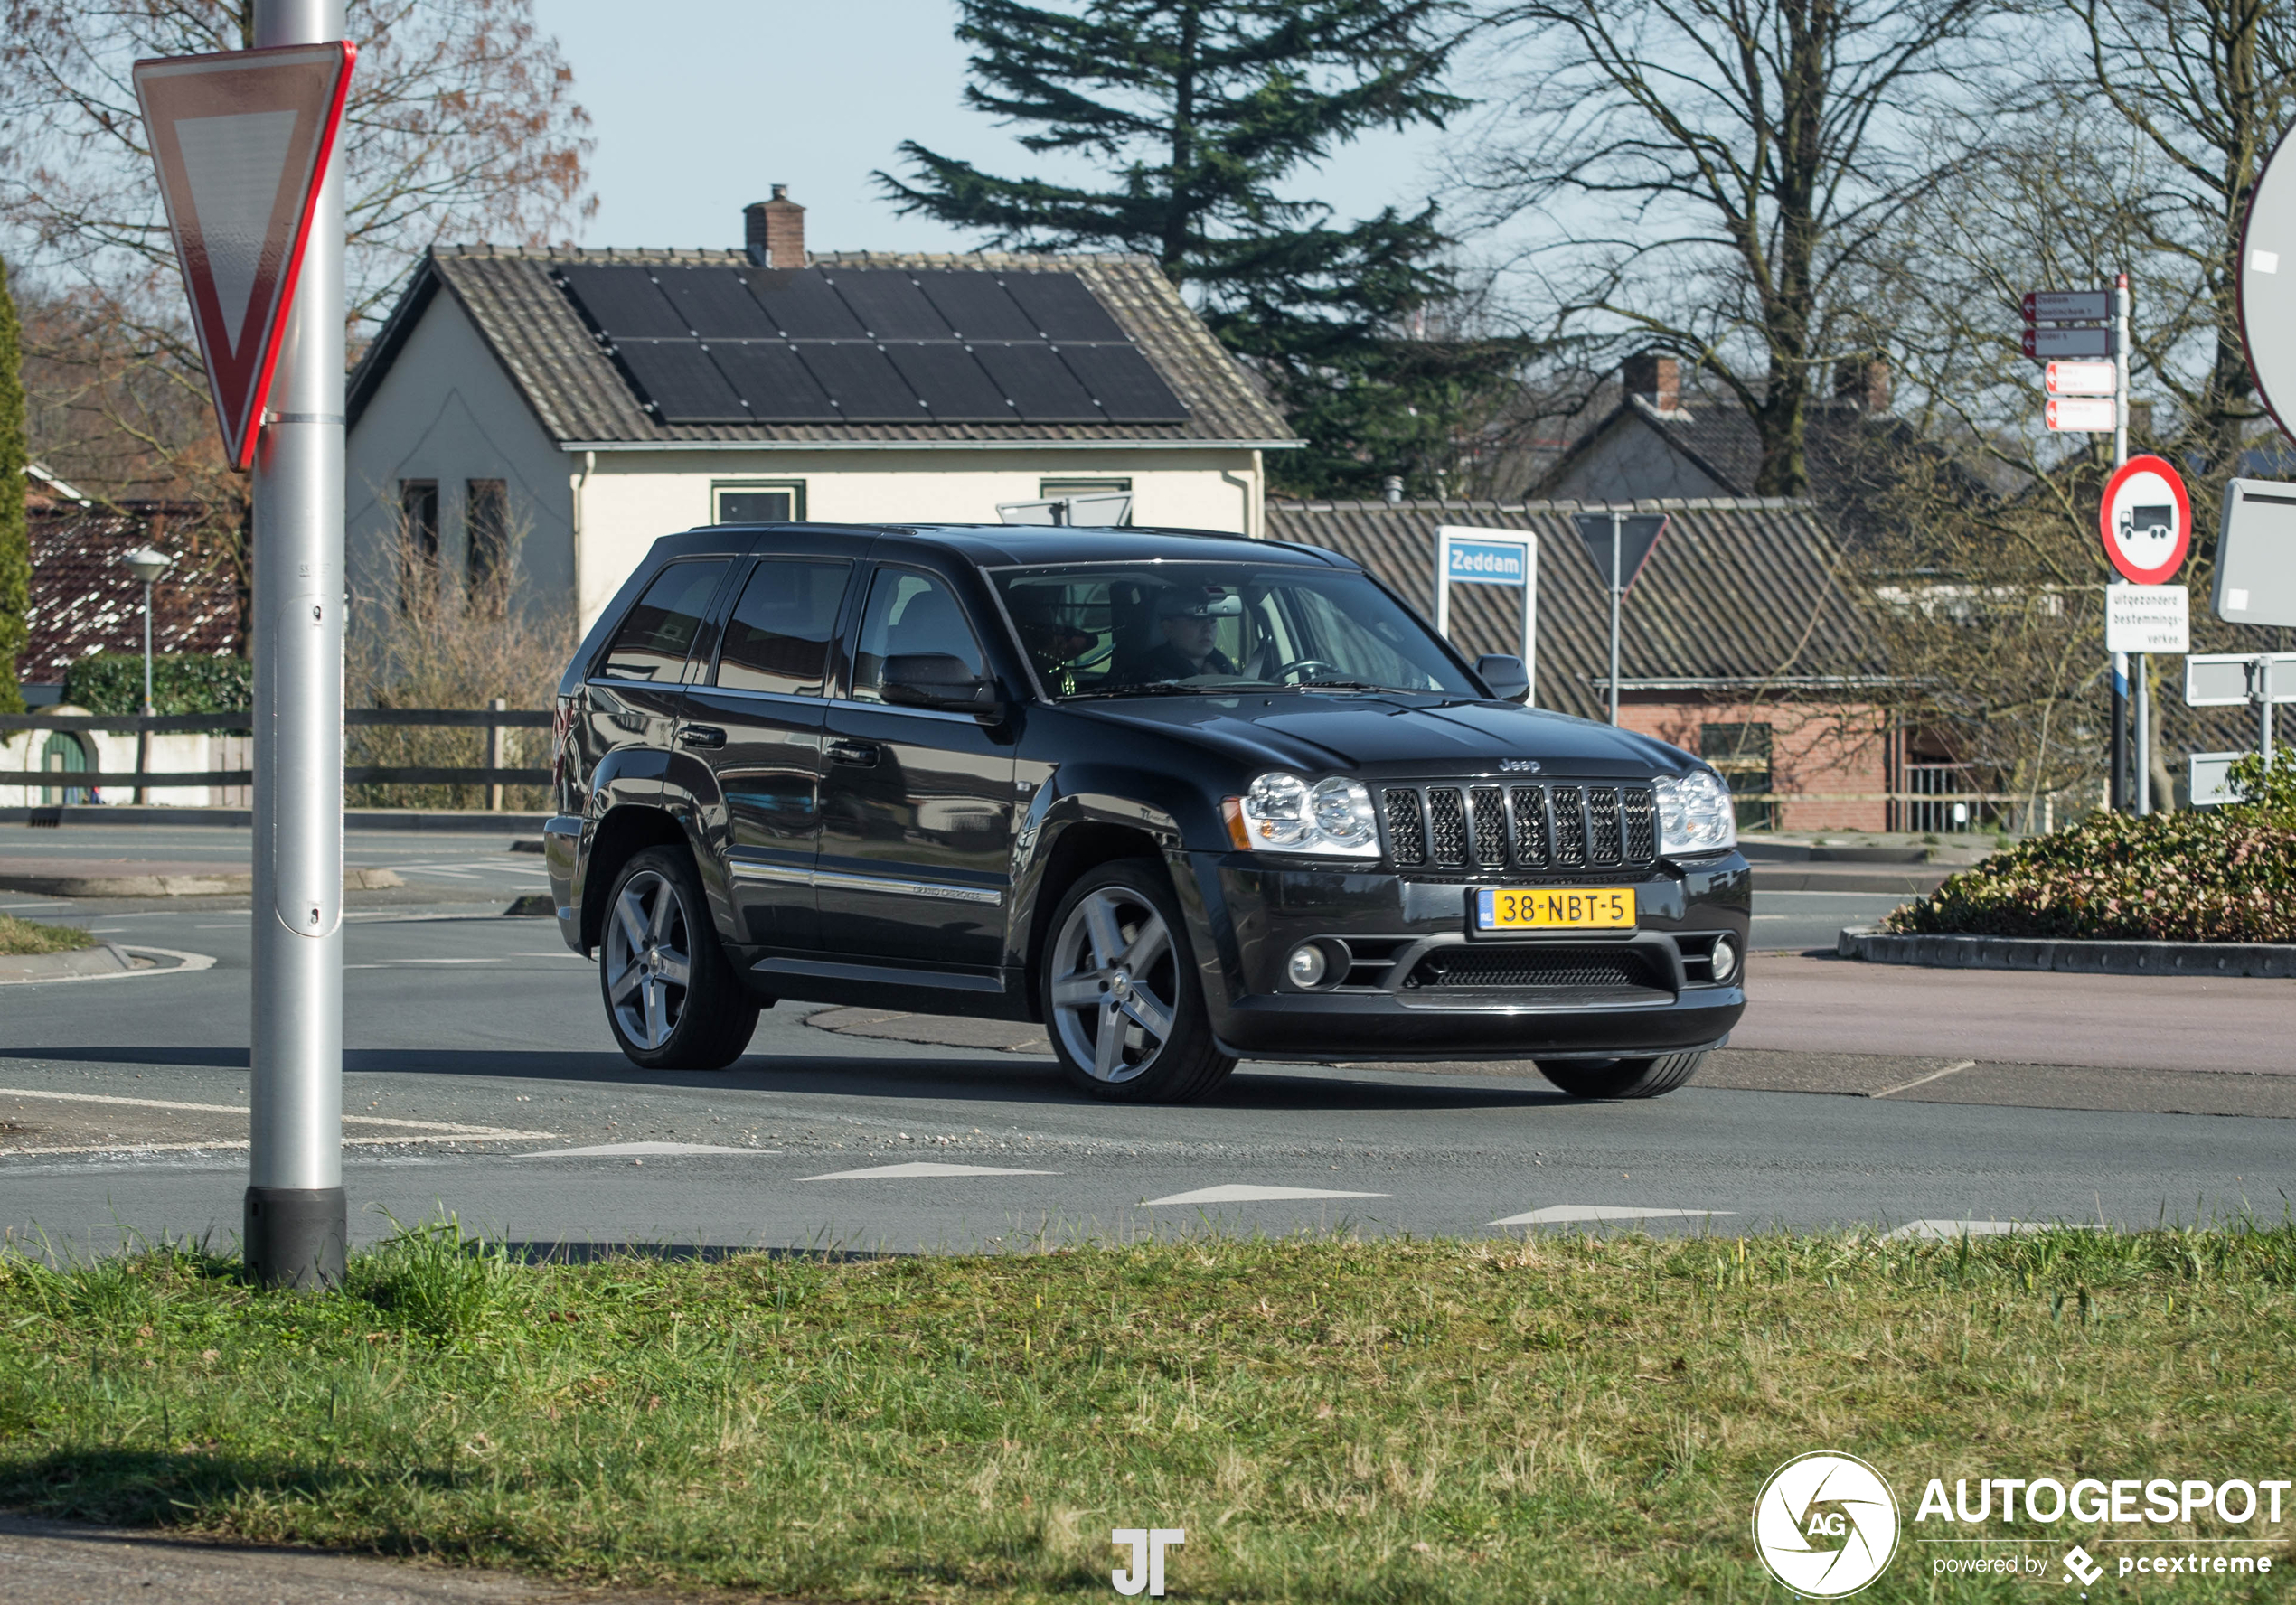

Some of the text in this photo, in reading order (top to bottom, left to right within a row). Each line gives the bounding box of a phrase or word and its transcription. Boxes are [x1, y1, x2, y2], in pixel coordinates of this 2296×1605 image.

[1451, 549, 1520, 574] Zeddam
[2114, 594, 2178, 607] uitgezonderd
[1498, 758, 1541, 773] Jeep
[1503, 895, 1623, 921] 38-NBT-5
